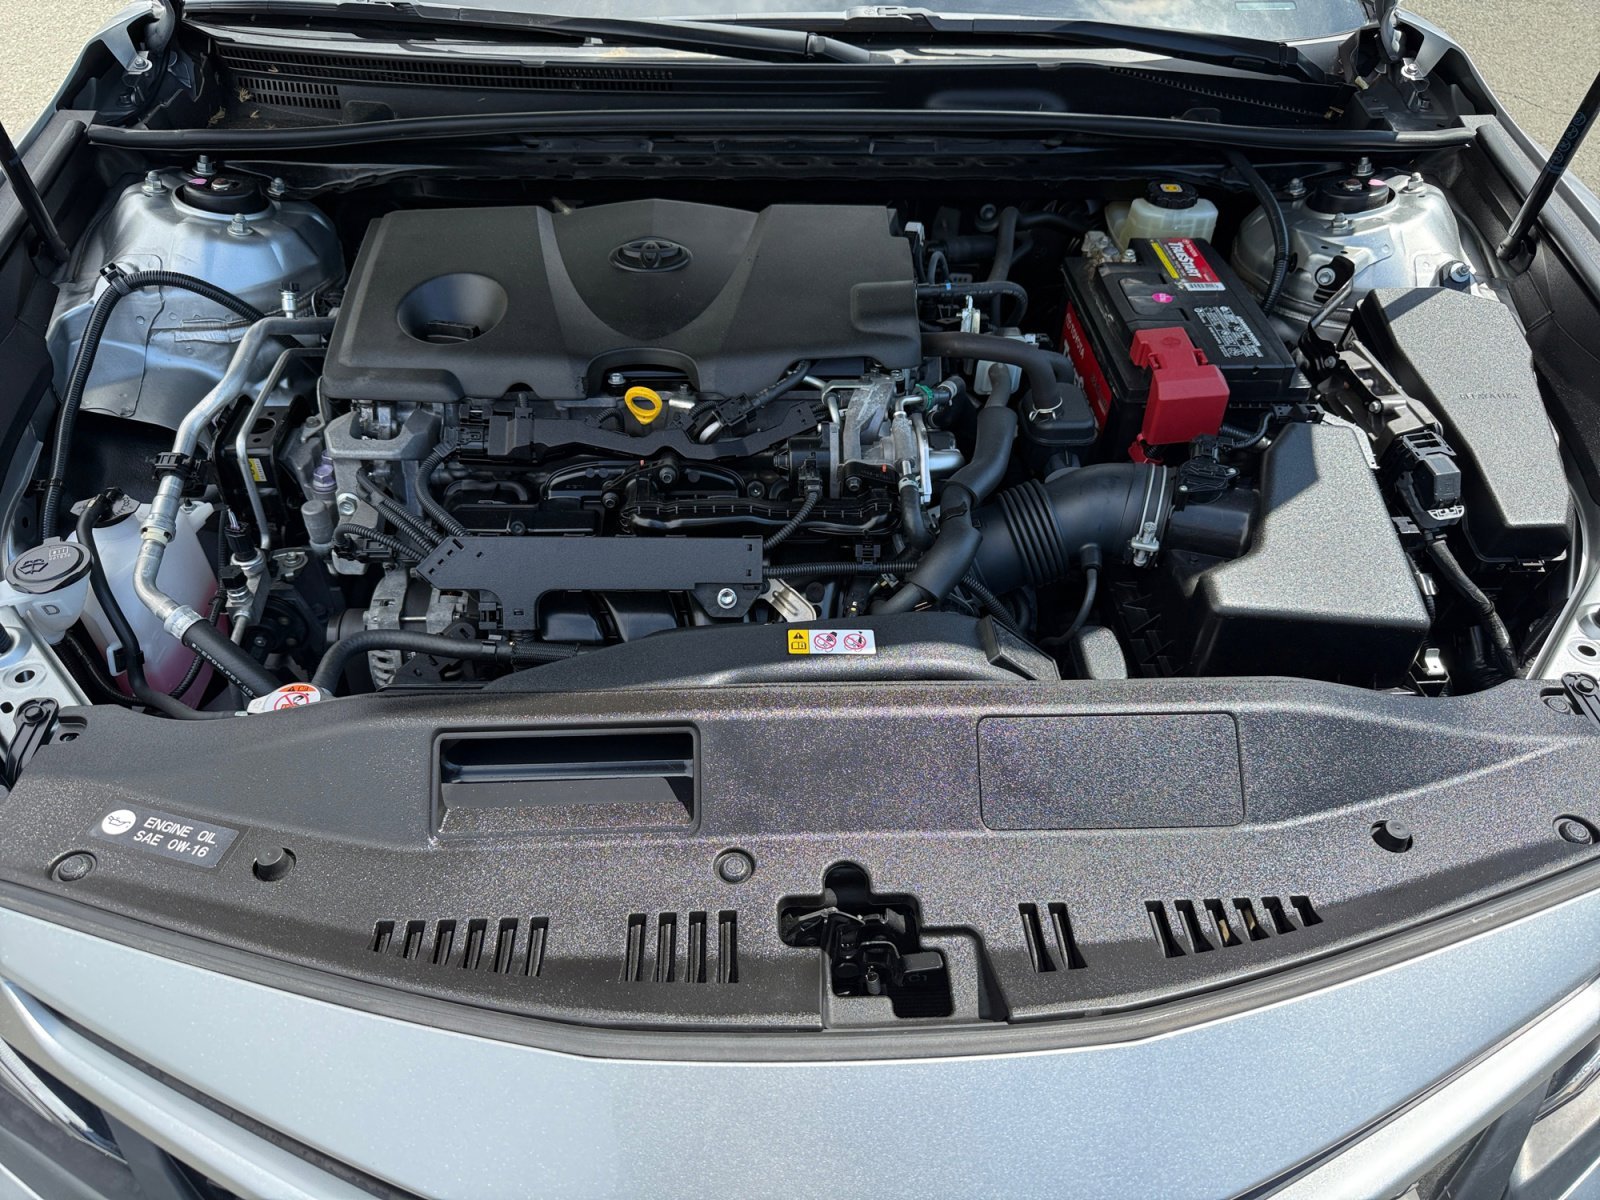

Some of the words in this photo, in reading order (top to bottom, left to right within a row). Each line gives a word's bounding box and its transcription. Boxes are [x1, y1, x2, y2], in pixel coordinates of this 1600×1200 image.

[133, 830, 164, 847] SAE
[167, 839, 209, 858] 0W-16
[143, 817, 193, 838] ENGINE
[197, 830, 216, 845] OIL
